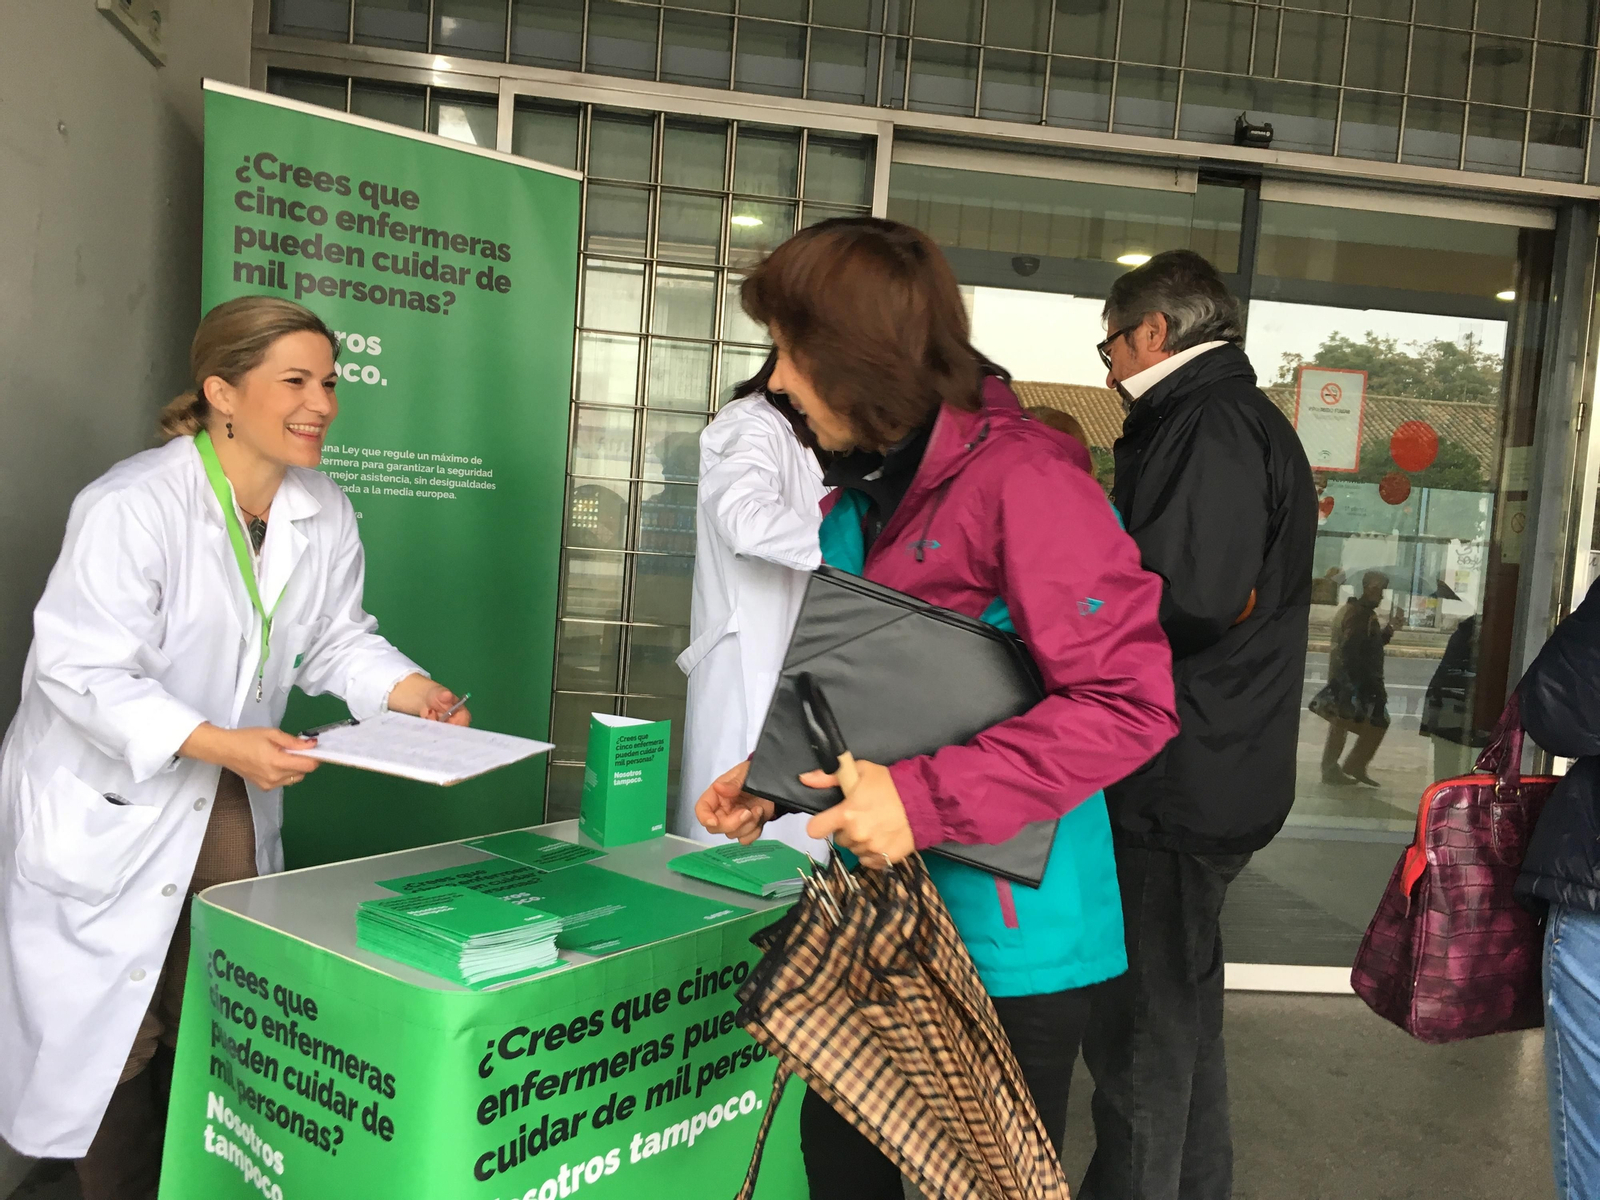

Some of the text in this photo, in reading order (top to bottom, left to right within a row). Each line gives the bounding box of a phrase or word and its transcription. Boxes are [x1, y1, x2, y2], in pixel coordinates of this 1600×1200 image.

[235, 152, 420, 211] ¿Crees que
[234, 186, 511, 263] cinco enfermeras
[233, 259, 456, 316] mil personas?
[234, 224, 512, 293] pueden cuidar de
[329, 471, 359, 482] mejor
[360, 473, 412, 486] asistencia,
[413, 475, 428, 485] sin
[429, 476, 497, 490] desigualdades
[342, 444, 360, 457] Ley
[362, 447, 381, 457] que
[383, 449, 415, 461] regule
[417, 452, 430, 461] un
[431, 452, 469, 465] máximo
[470, 456, 483, 465] de
[361, 461, 384, 471] para
[386, 462, 434, 473] garantizar
[436, 464, 445, 474] la
[447, 466, 493, 478] seguridad
[362, 486, 370, 494] a
[371, 484, 382, 495] la
[383, 486, 414, 497] media
[416, 489, 457, 500] europea.
[613, 770, 642, 778] Nosotros
[615, 750, 640, 760] pueden
[640, 747, 657, 755] cuidar
[616, 739, 664, 751] cinco enfermeras
[625, 754, 655, 767] personas?
[273, 983, 318, 1021] que
[478, 960, 749, 1079] ¿Crees que cinco
[210, 983, 395, 1099] cinco enfermeras
[476, 1004, 746, 1126] enfermeras pue
[210, 1054, 344, 1156] mil personas?
[211, 1018, 395, 1141] pueden cuidar de
[206, 1091, 284, 1175] Nosotros
[474, 1042, 774, 1182] cuidar de mil perso
[492, 1090, 763, 1200] otros tampoco.
